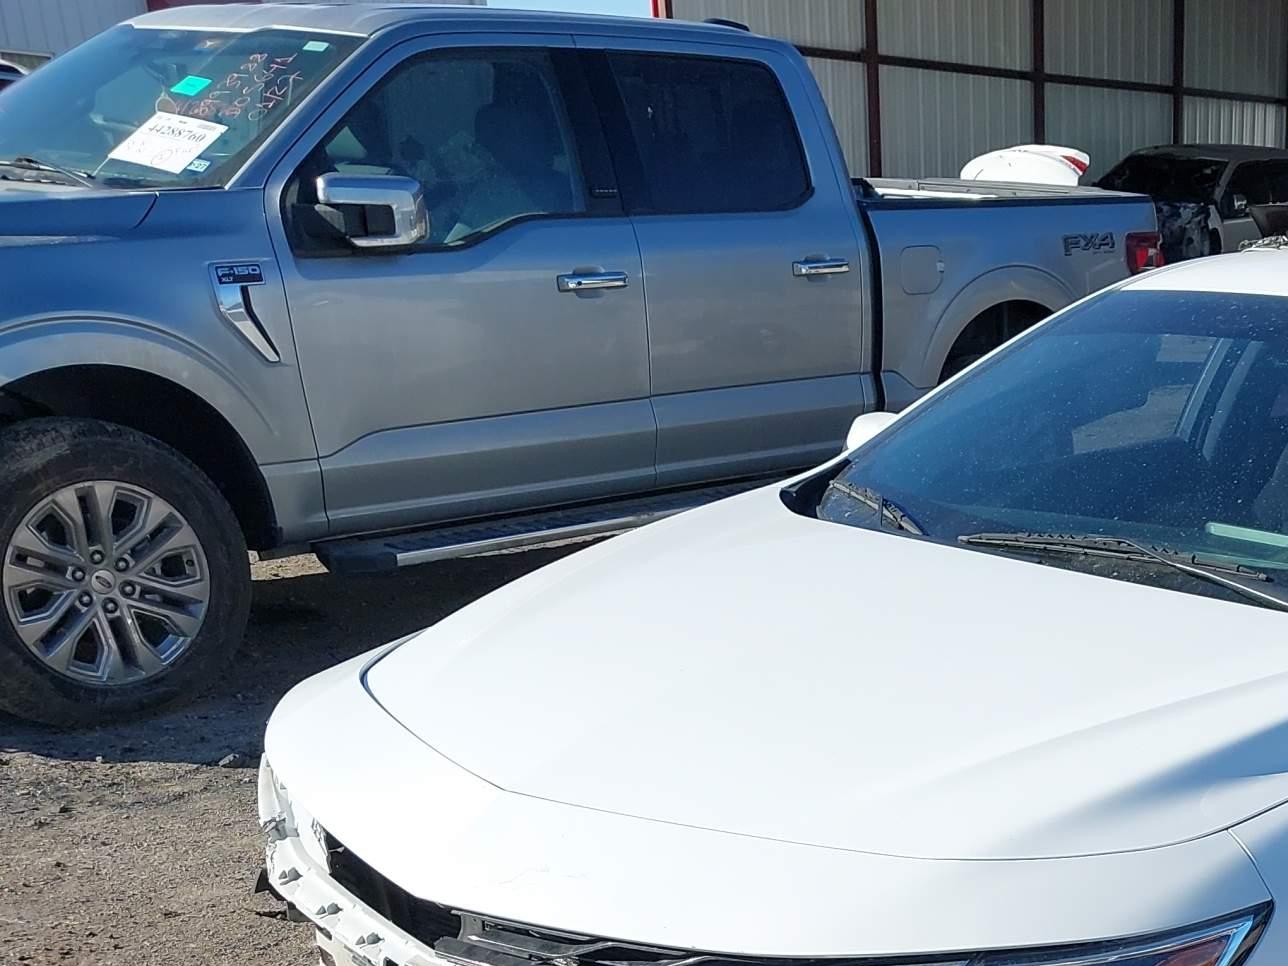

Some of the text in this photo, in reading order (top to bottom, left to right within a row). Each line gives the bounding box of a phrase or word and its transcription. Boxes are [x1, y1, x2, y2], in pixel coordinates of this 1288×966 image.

[148, 123, 207, 143] 44288760
[1062, 231, 1116, 257] FX4
[216, 265, 261, 278] F-150
